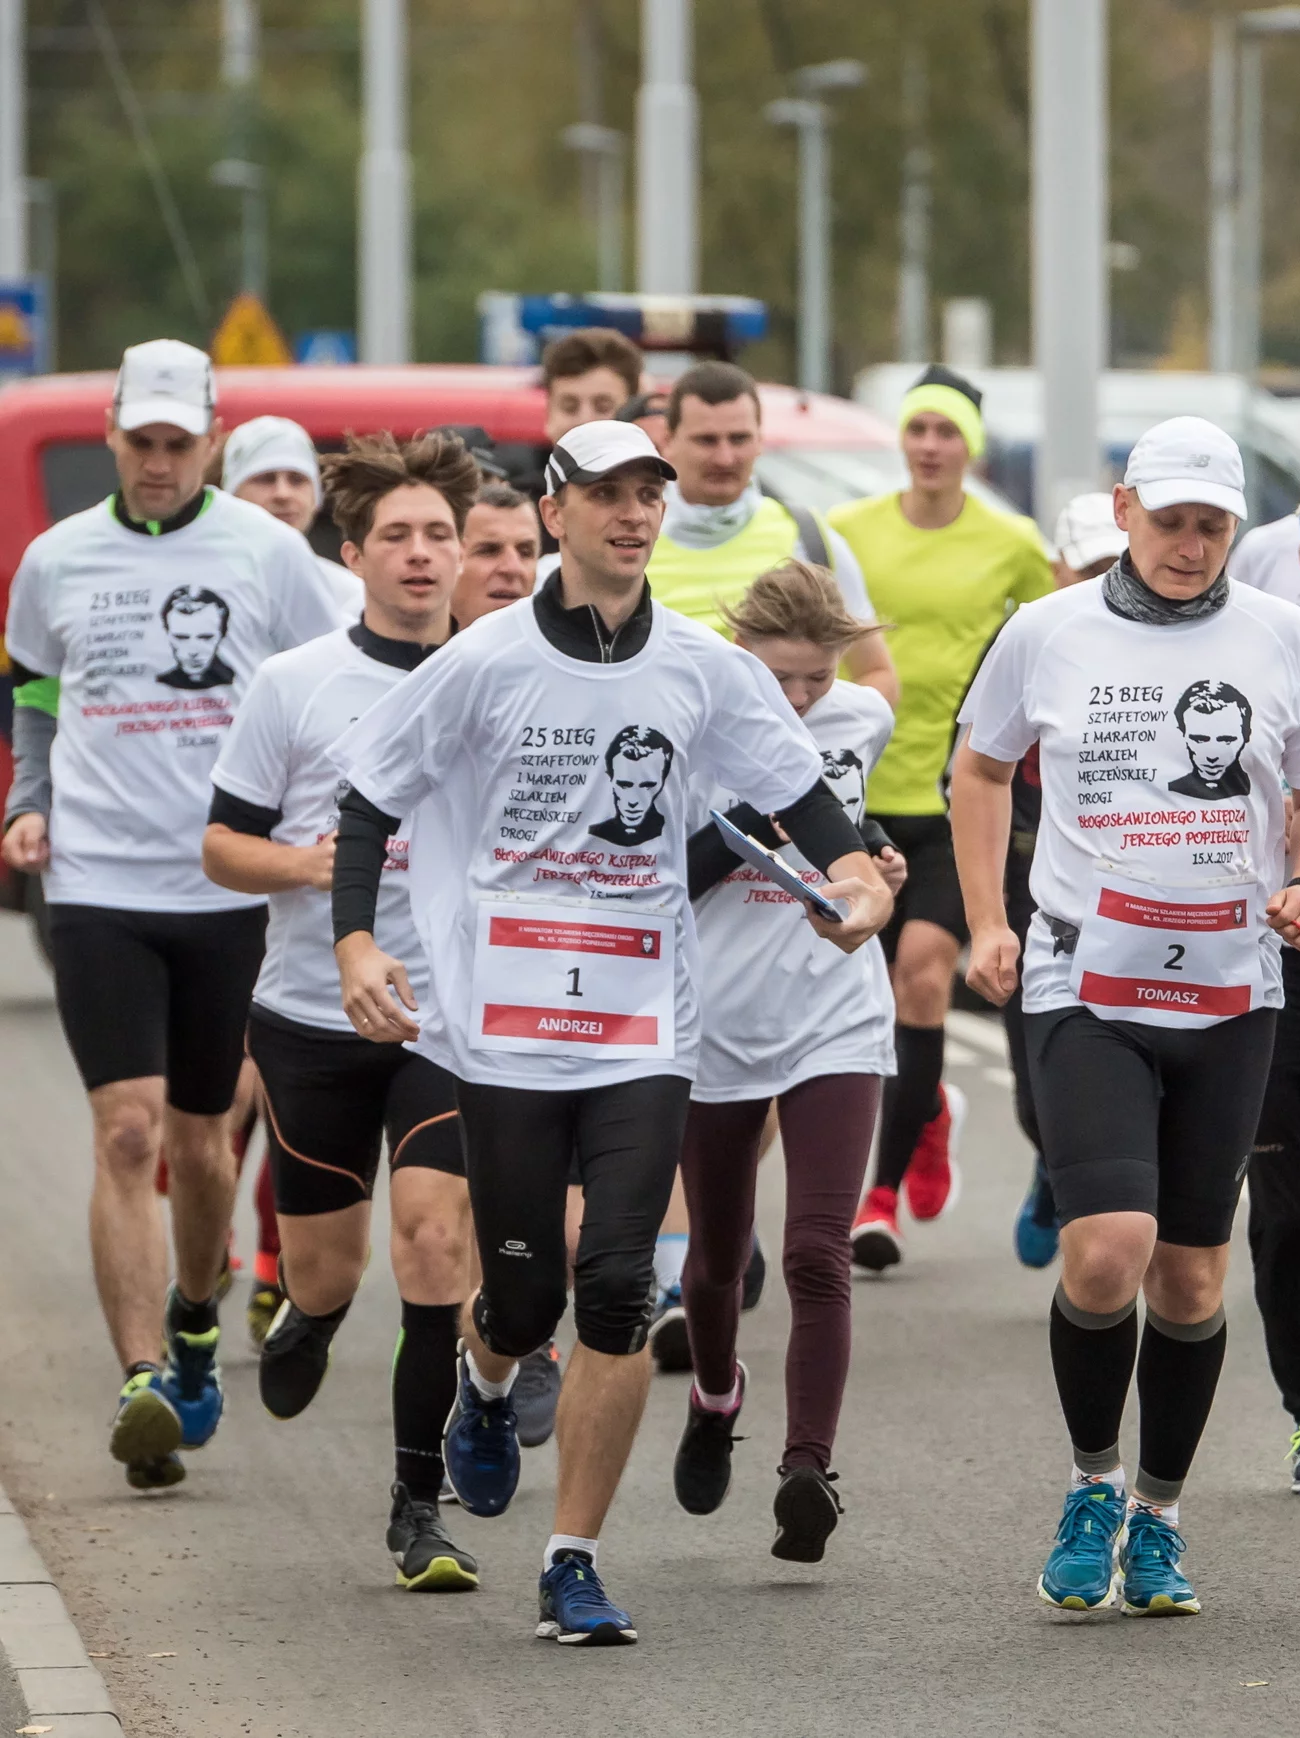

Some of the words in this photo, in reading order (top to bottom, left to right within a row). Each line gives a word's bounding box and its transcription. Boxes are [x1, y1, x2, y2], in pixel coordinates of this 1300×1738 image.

[90, 592, 110, 611] 25
[115, 589, 150, 605] BIEG
[1089, 685, 1114, 705] 25
[1118, 686, 1163, 703] BIEG
[1087, 710, 1169, 725] SZTAFETOWY
[521, 726, 547, 747] 25
[552, 728, 595, 746] BIEG
[1082, 732, 1088, 744] I
[1093, 729, 1157, 744] MARATON
[521, 754, 599, 768] SZTAFETOWY
[1078, 749, 1138, 764] SZLAKIEM
[517, 772, 522, 783] I
[527, 774, 587, 785] MARATON
[1077, 766, 1157, 785] MĘCZEŃSKIEJ
[509, 790, 566, 804] SZLAKIEM
[1078, 791, 1113, 805] DROGI
[503, 807, 582, 823] MĘCZEŃSKIEJ
[1077, 810, 1197, 829] BŁOGOSŁAWIONEGO
[1200, 809, 1246, 826] KSIĘDZA
[500, 827, 538, 841] DROGI
[1120, 831, 1181, 850] JERZEGO
[1192, 851, 1234, 865] 15.X.2017
[1163, 944, 1186, 971] 2
[566, 967, 583, 997] 1
[1136, 987, 1200, 1005] TOMASZ
[537, 1017, 603, 1035] ANDRZEJ
